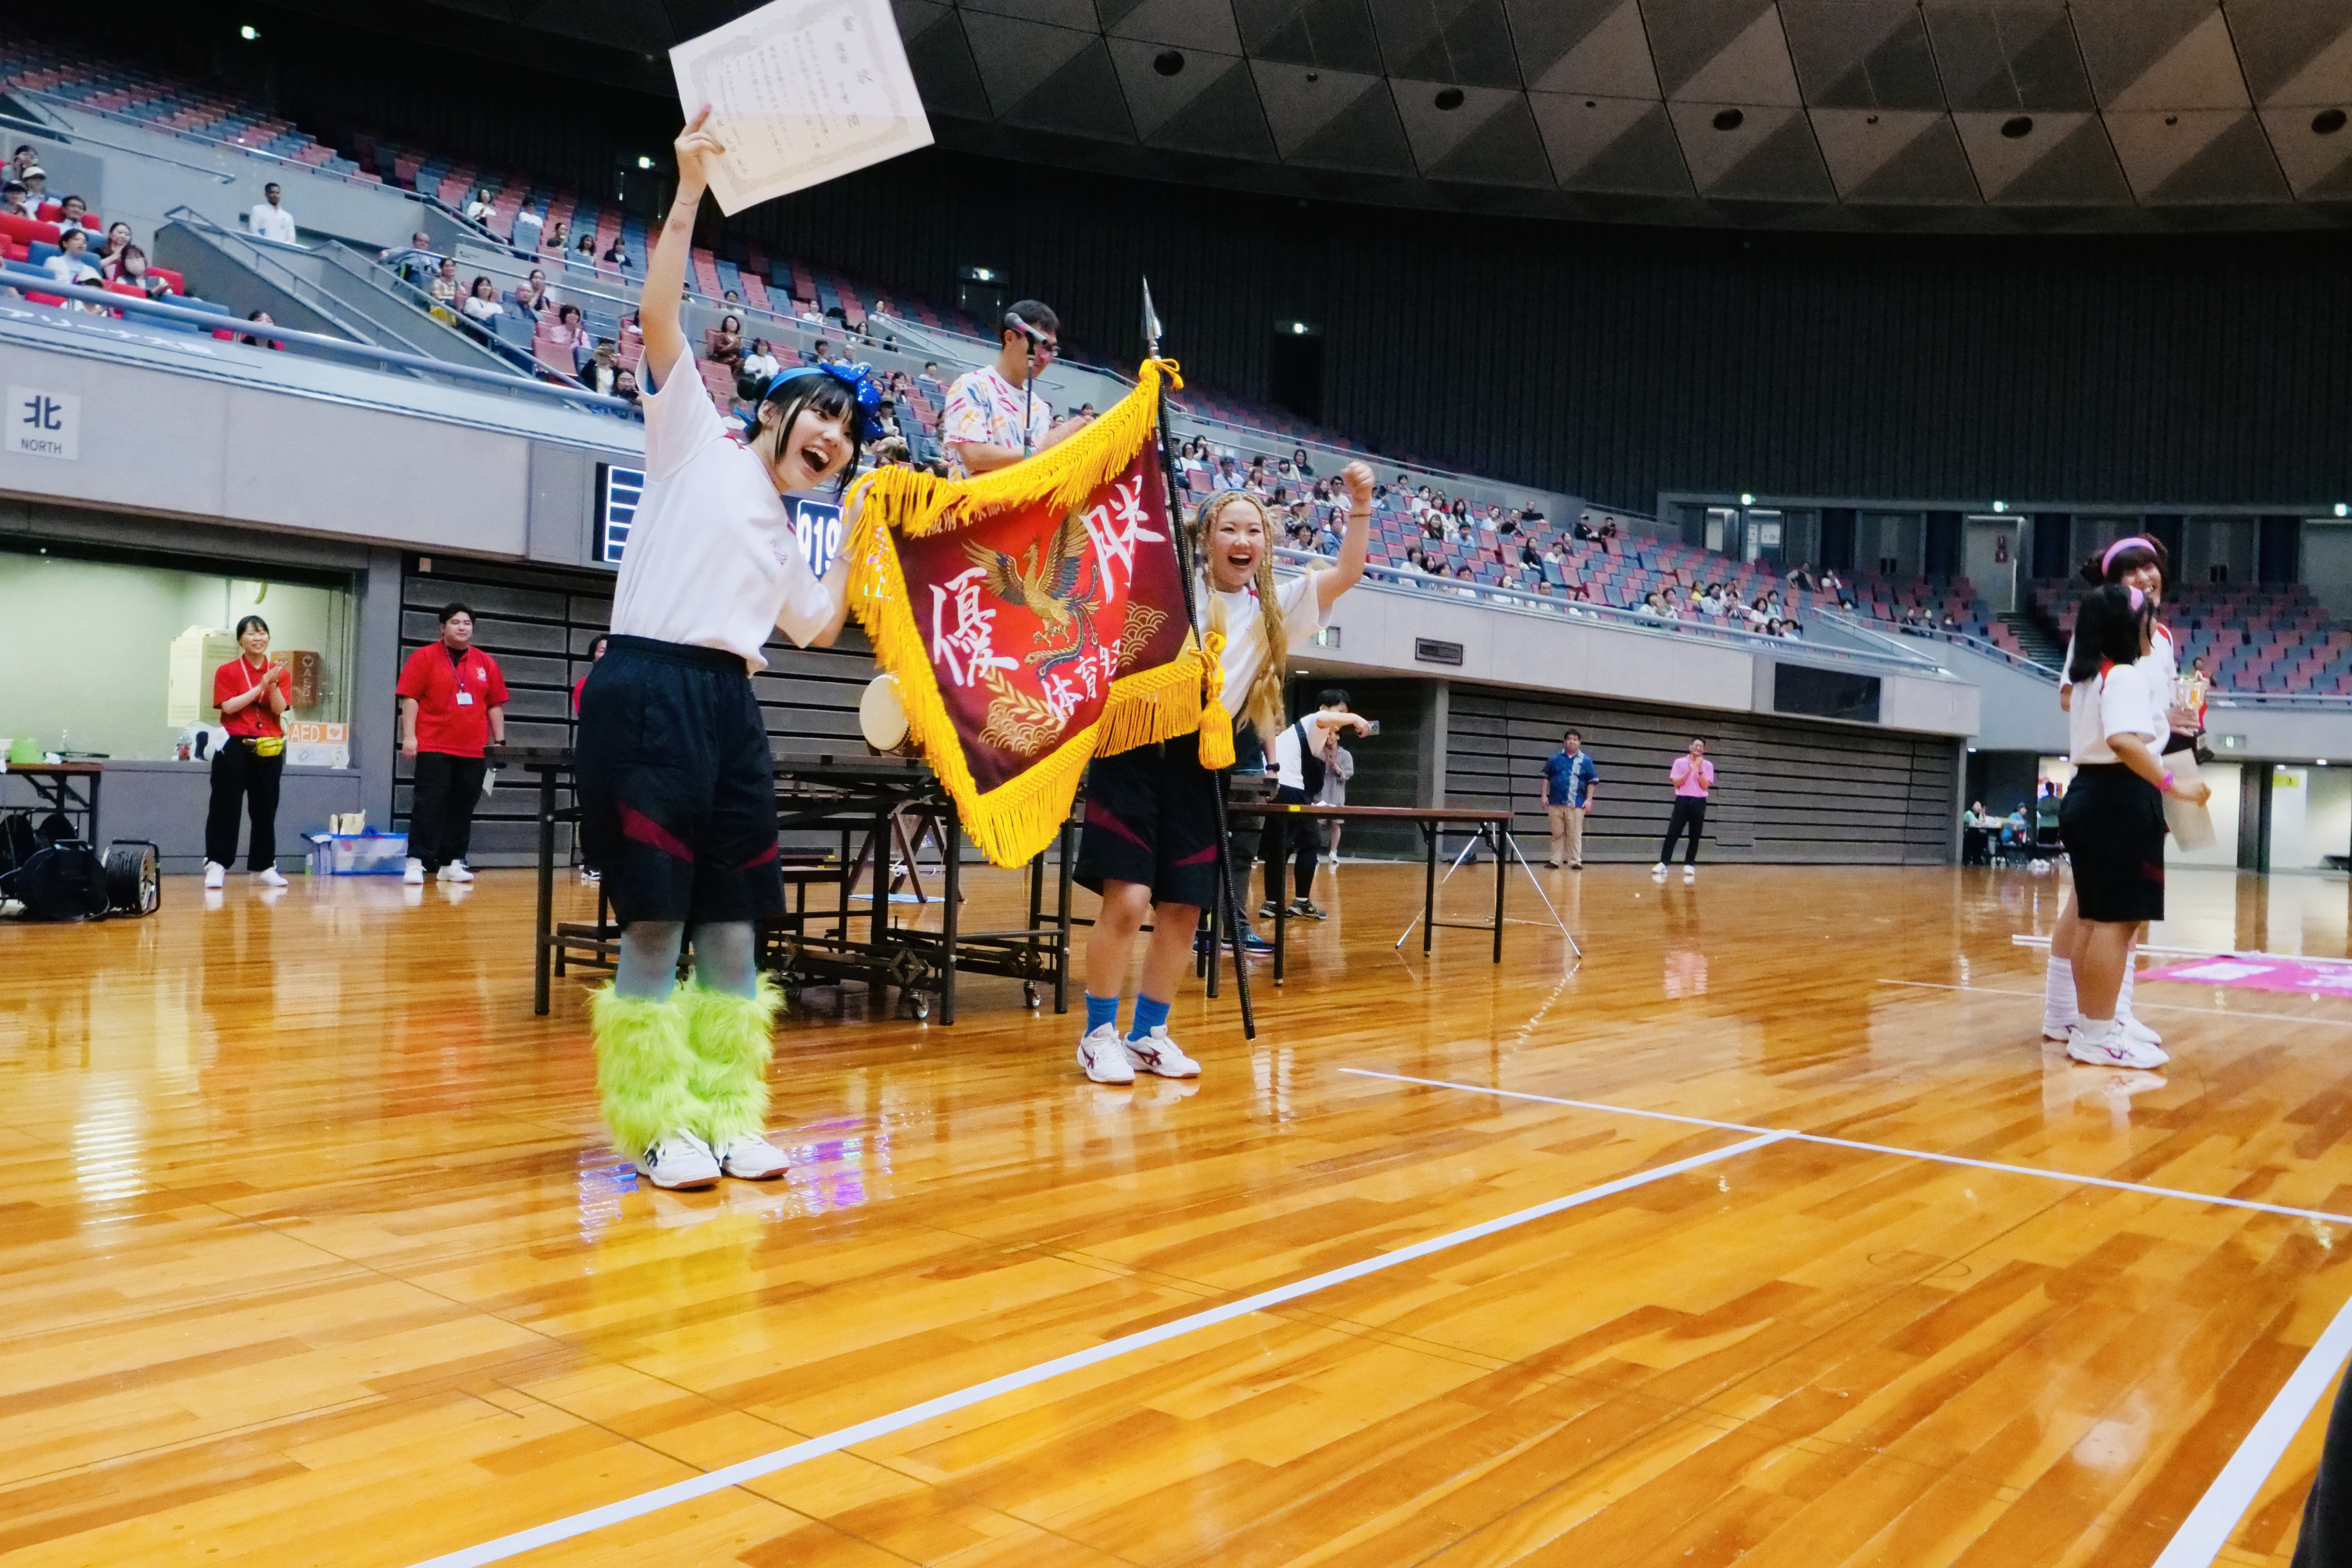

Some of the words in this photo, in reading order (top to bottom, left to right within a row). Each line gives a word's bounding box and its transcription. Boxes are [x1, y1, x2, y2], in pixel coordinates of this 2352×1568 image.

[23, 395, 63, 430] 北
[21, 438, 62, 454] NORTH
[291, 724, 320, 743] AED
